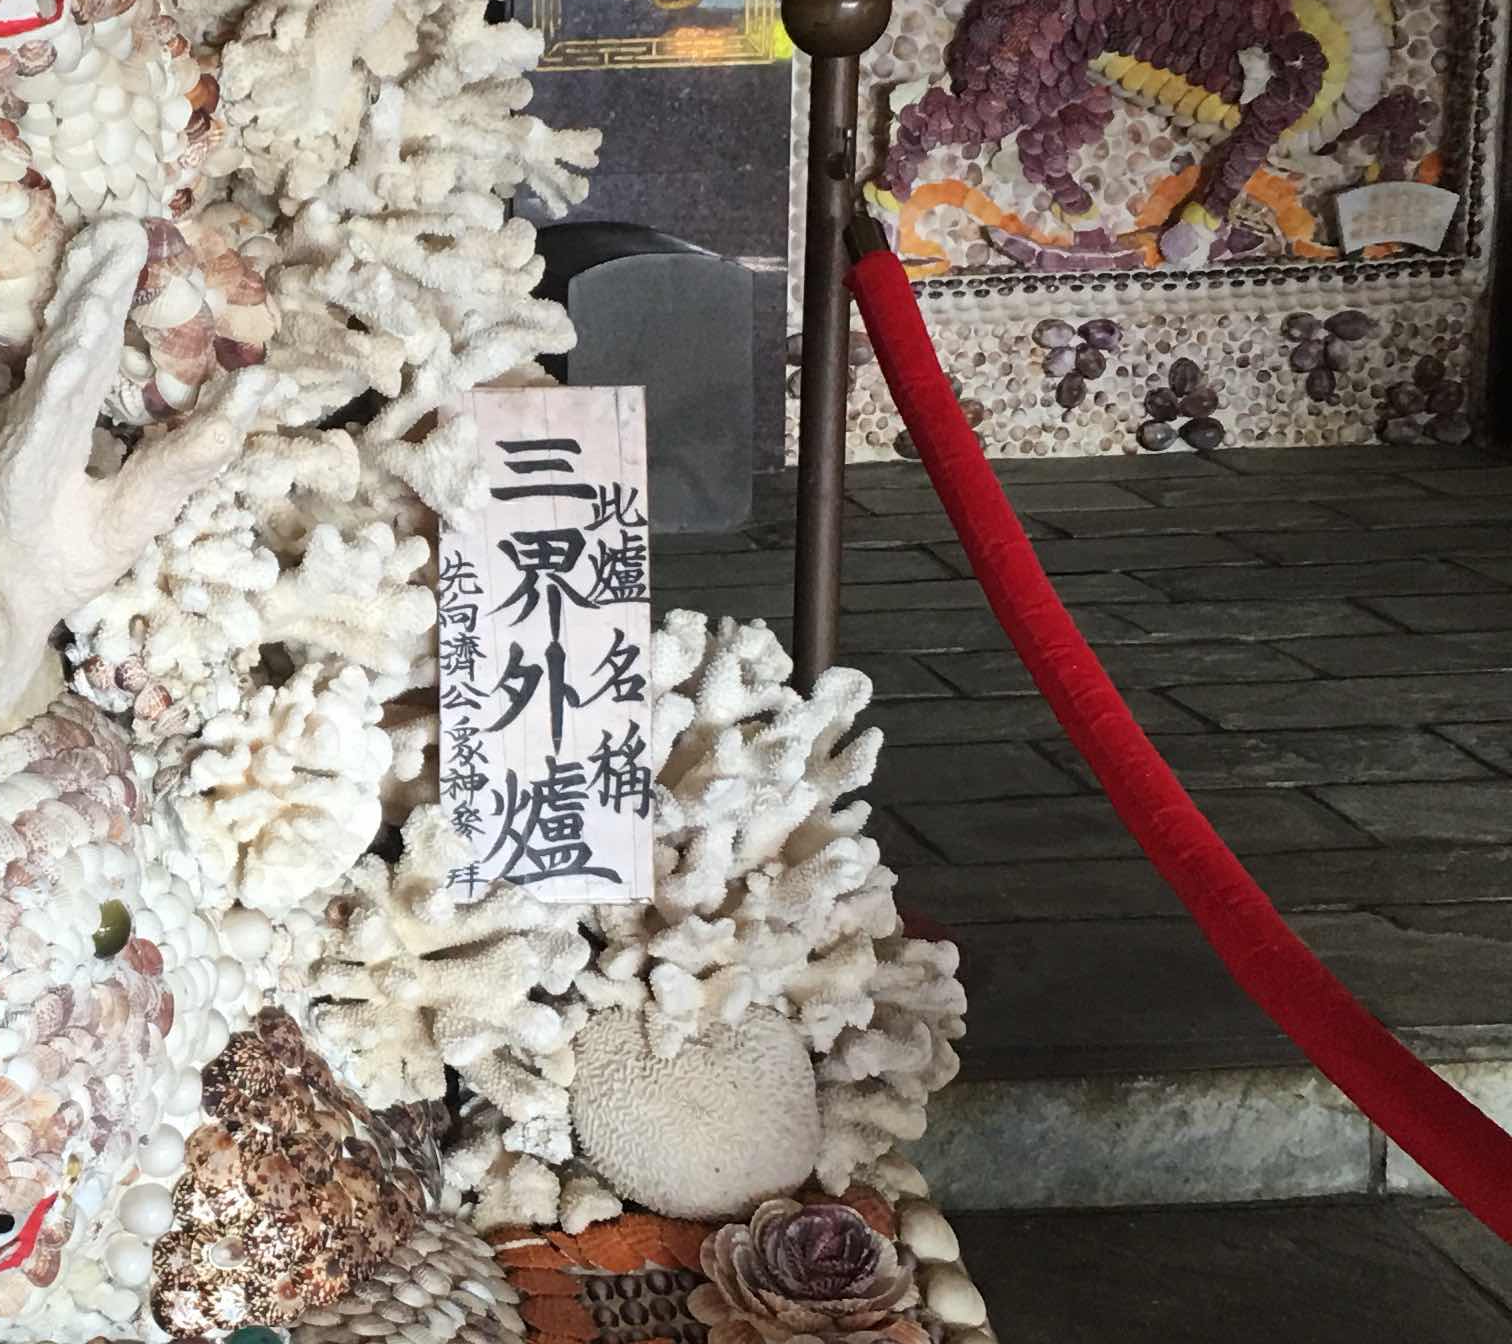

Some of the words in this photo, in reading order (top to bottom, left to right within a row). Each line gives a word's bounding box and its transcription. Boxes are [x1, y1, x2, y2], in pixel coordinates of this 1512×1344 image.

[486, 438, 623, 884] 三界外爐
[583, 482, 656, 819] 此爐名稱
